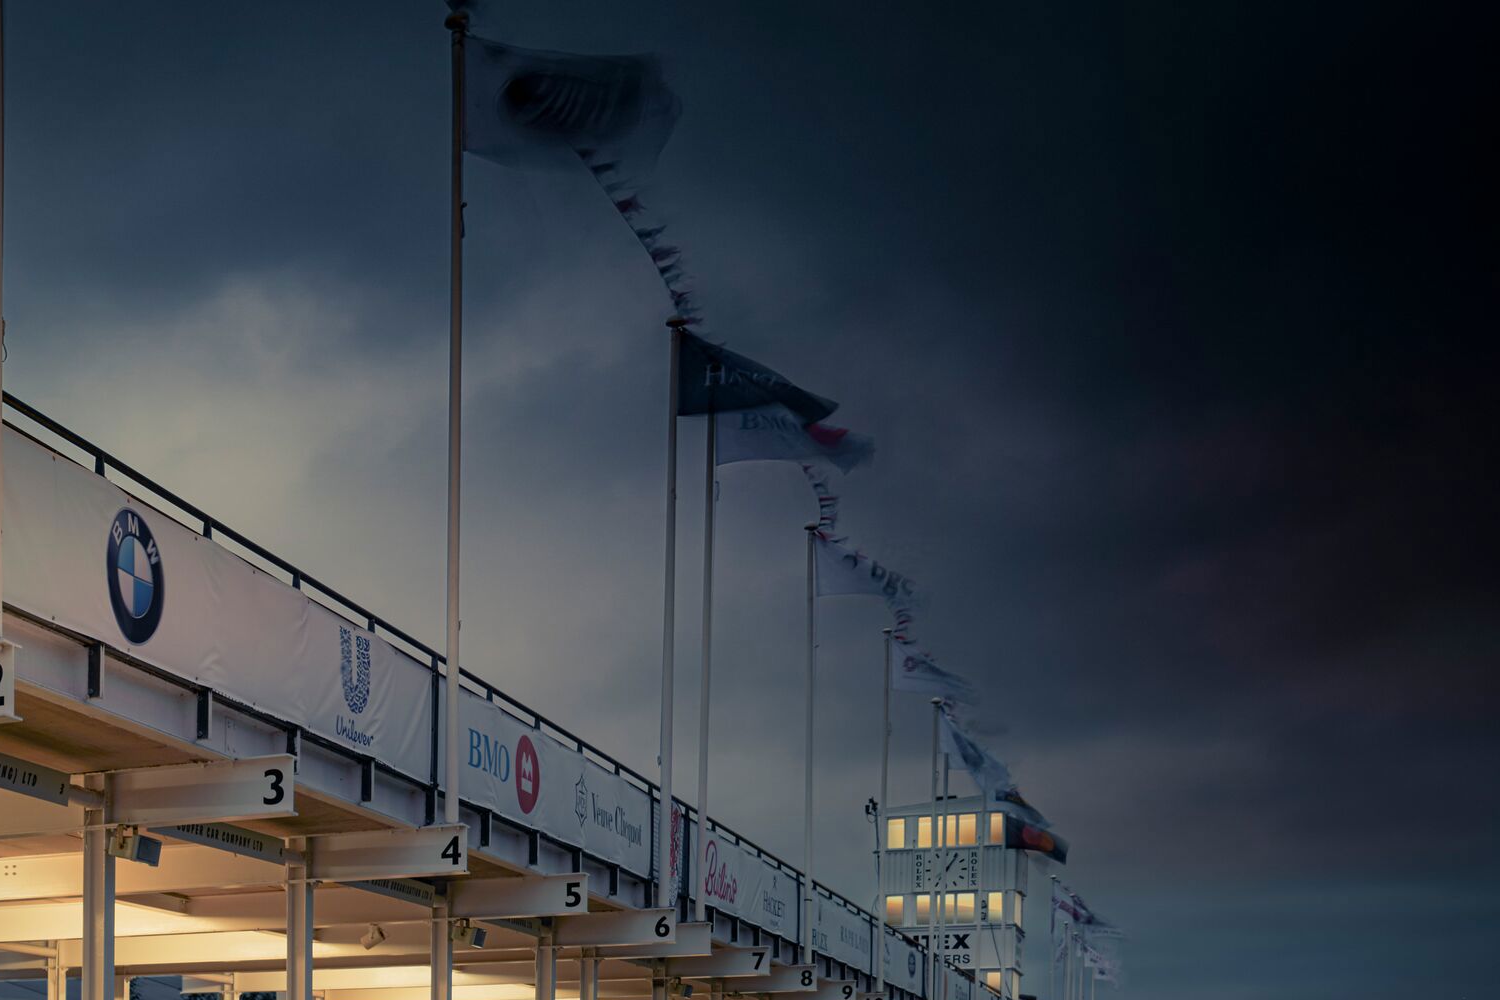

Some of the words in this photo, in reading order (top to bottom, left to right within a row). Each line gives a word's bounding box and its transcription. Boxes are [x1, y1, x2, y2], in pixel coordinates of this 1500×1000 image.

[112, 511, 160, 566] BMW
[335, 714, 374, 748] Unilever
[468, 727, 510, 783] BMO
[21, 771, 37, 787] LTD
[262, 769, 285, 804] 3
[592, 792, 613, 831] Veuve
[615, 806, 642, 848] Clicquot
[207, 827, 219, 841] CAR
[222, 832, 251, 849] COMPANY
[253, 841, 263, 852] LTD
[441, 836, 462, 865] 4
[915, 854, 923, 888] ROLEX
[970, 852, 978, 887] ROLEX
[565, 883, 581, 907] 5
[655, 916, 670, 937] 6
[752, 952, 765, 970] 7
[801, 970, 812, 986] 8
[842, 985, 853, 1000] 9
